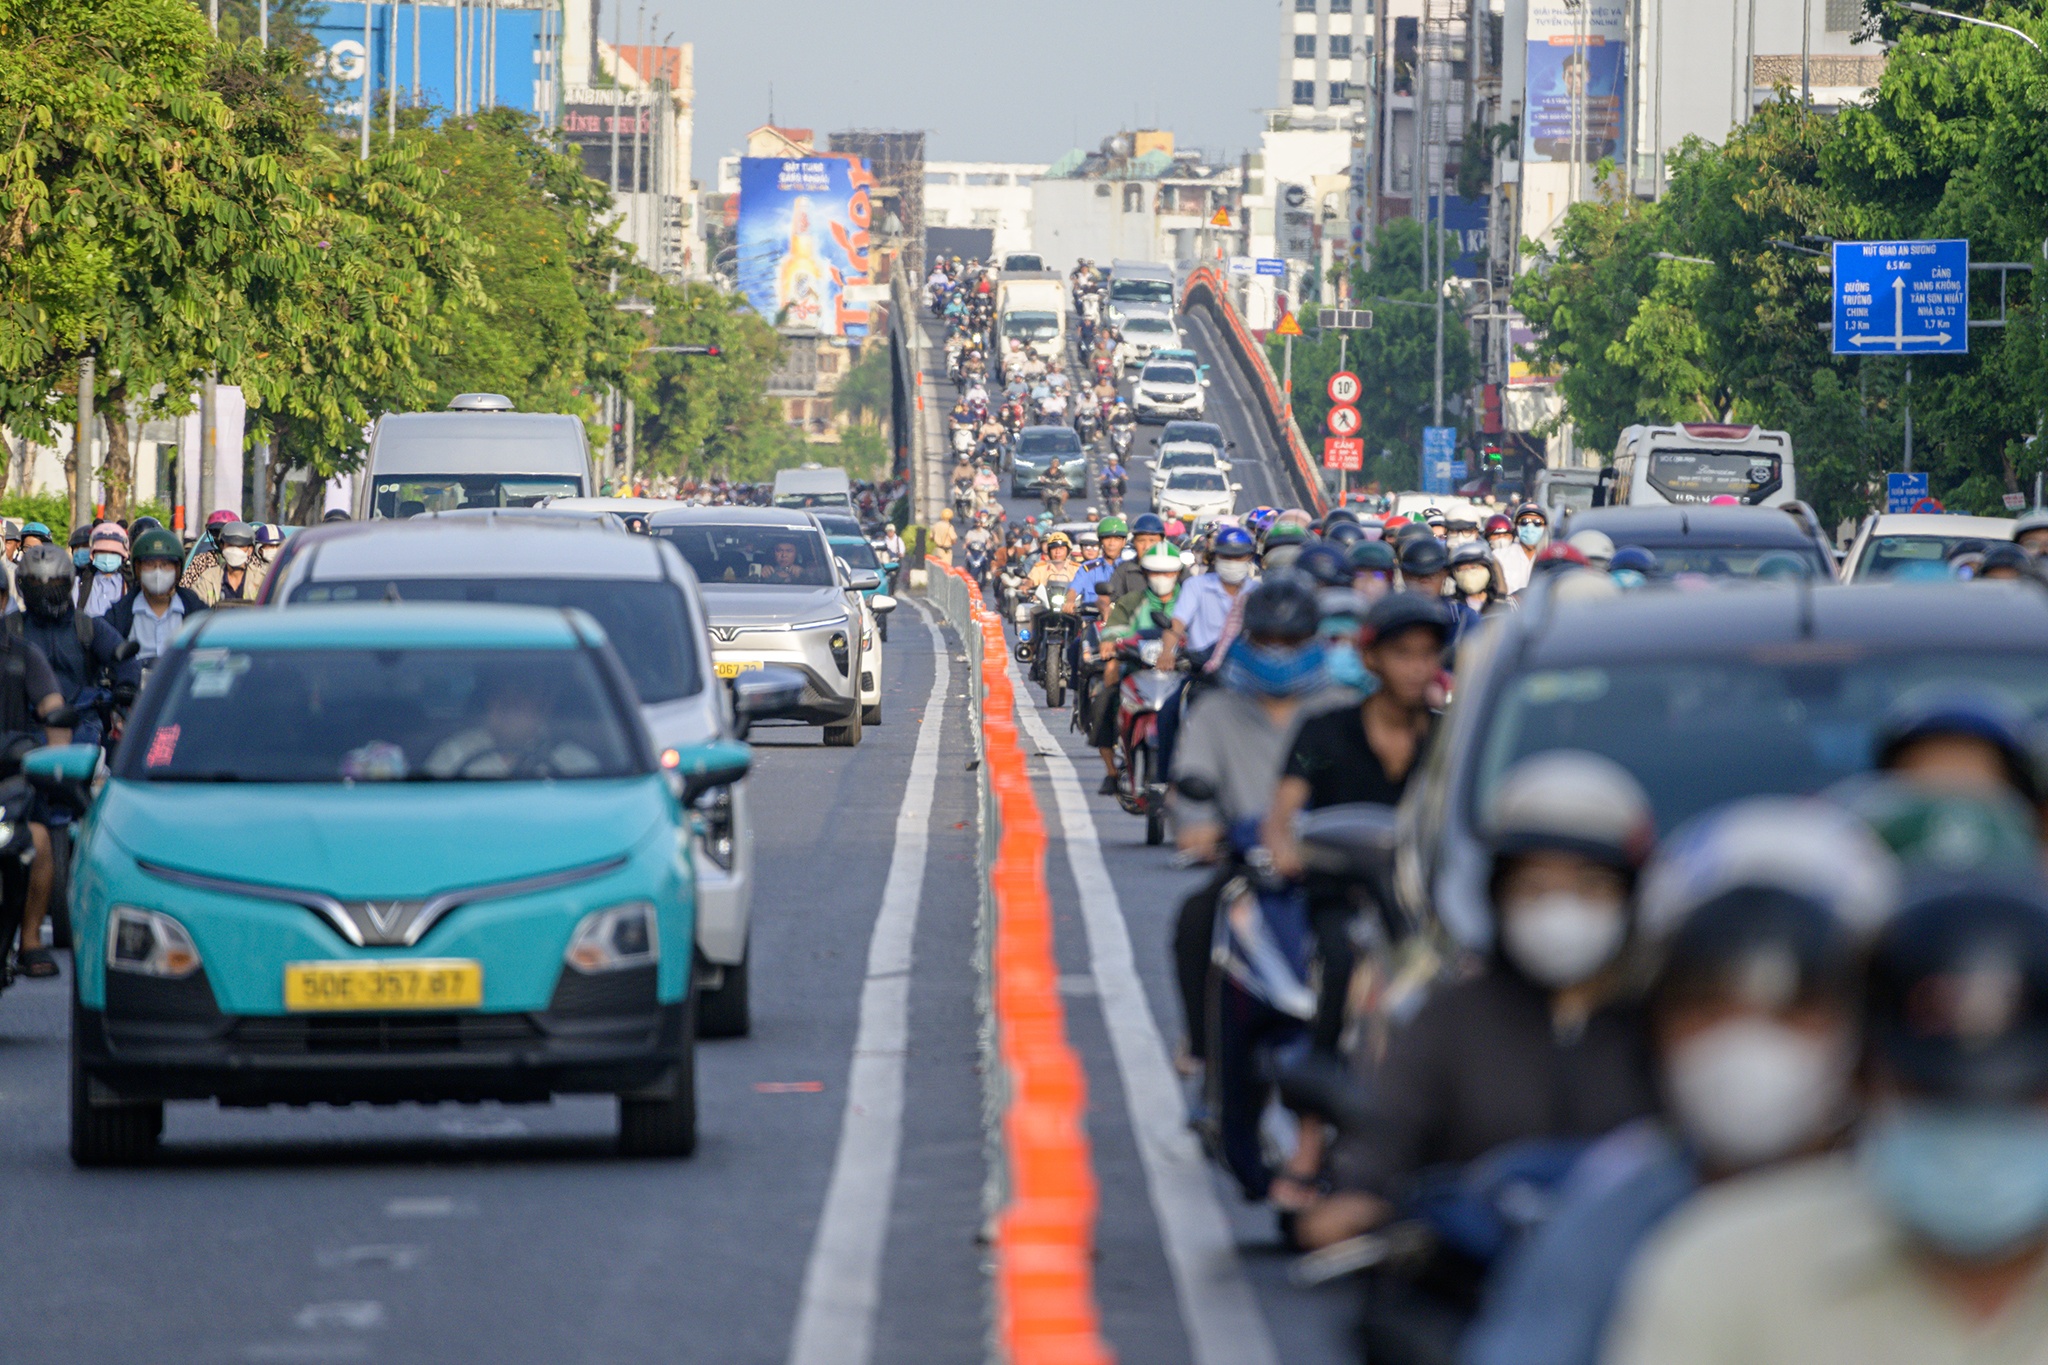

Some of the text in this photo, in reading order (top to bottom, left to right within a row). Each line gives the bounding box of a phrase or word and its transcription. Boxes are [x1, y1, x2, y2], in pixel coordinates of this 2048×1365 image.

[1863, 243, 1936, 256] NÚT GIAO AN SƯƠNG
[1886, 261, 1911, 270] 6.5 Km
[1931, 265, 1951, 278] CẢNG
[1935, 280, 1961, 291] KHÔNG
[1911, 290, 1963, 304] TÂN SƠN NHẤT
[1846, 308, 1869, 317] CHINH
[1918, 304, 1933, 316] NHÀ
[1935, 306, 1945, 315] GA
[1858, 321, 1870, 330] Km
[1937, 320, 1950, 329] Km
